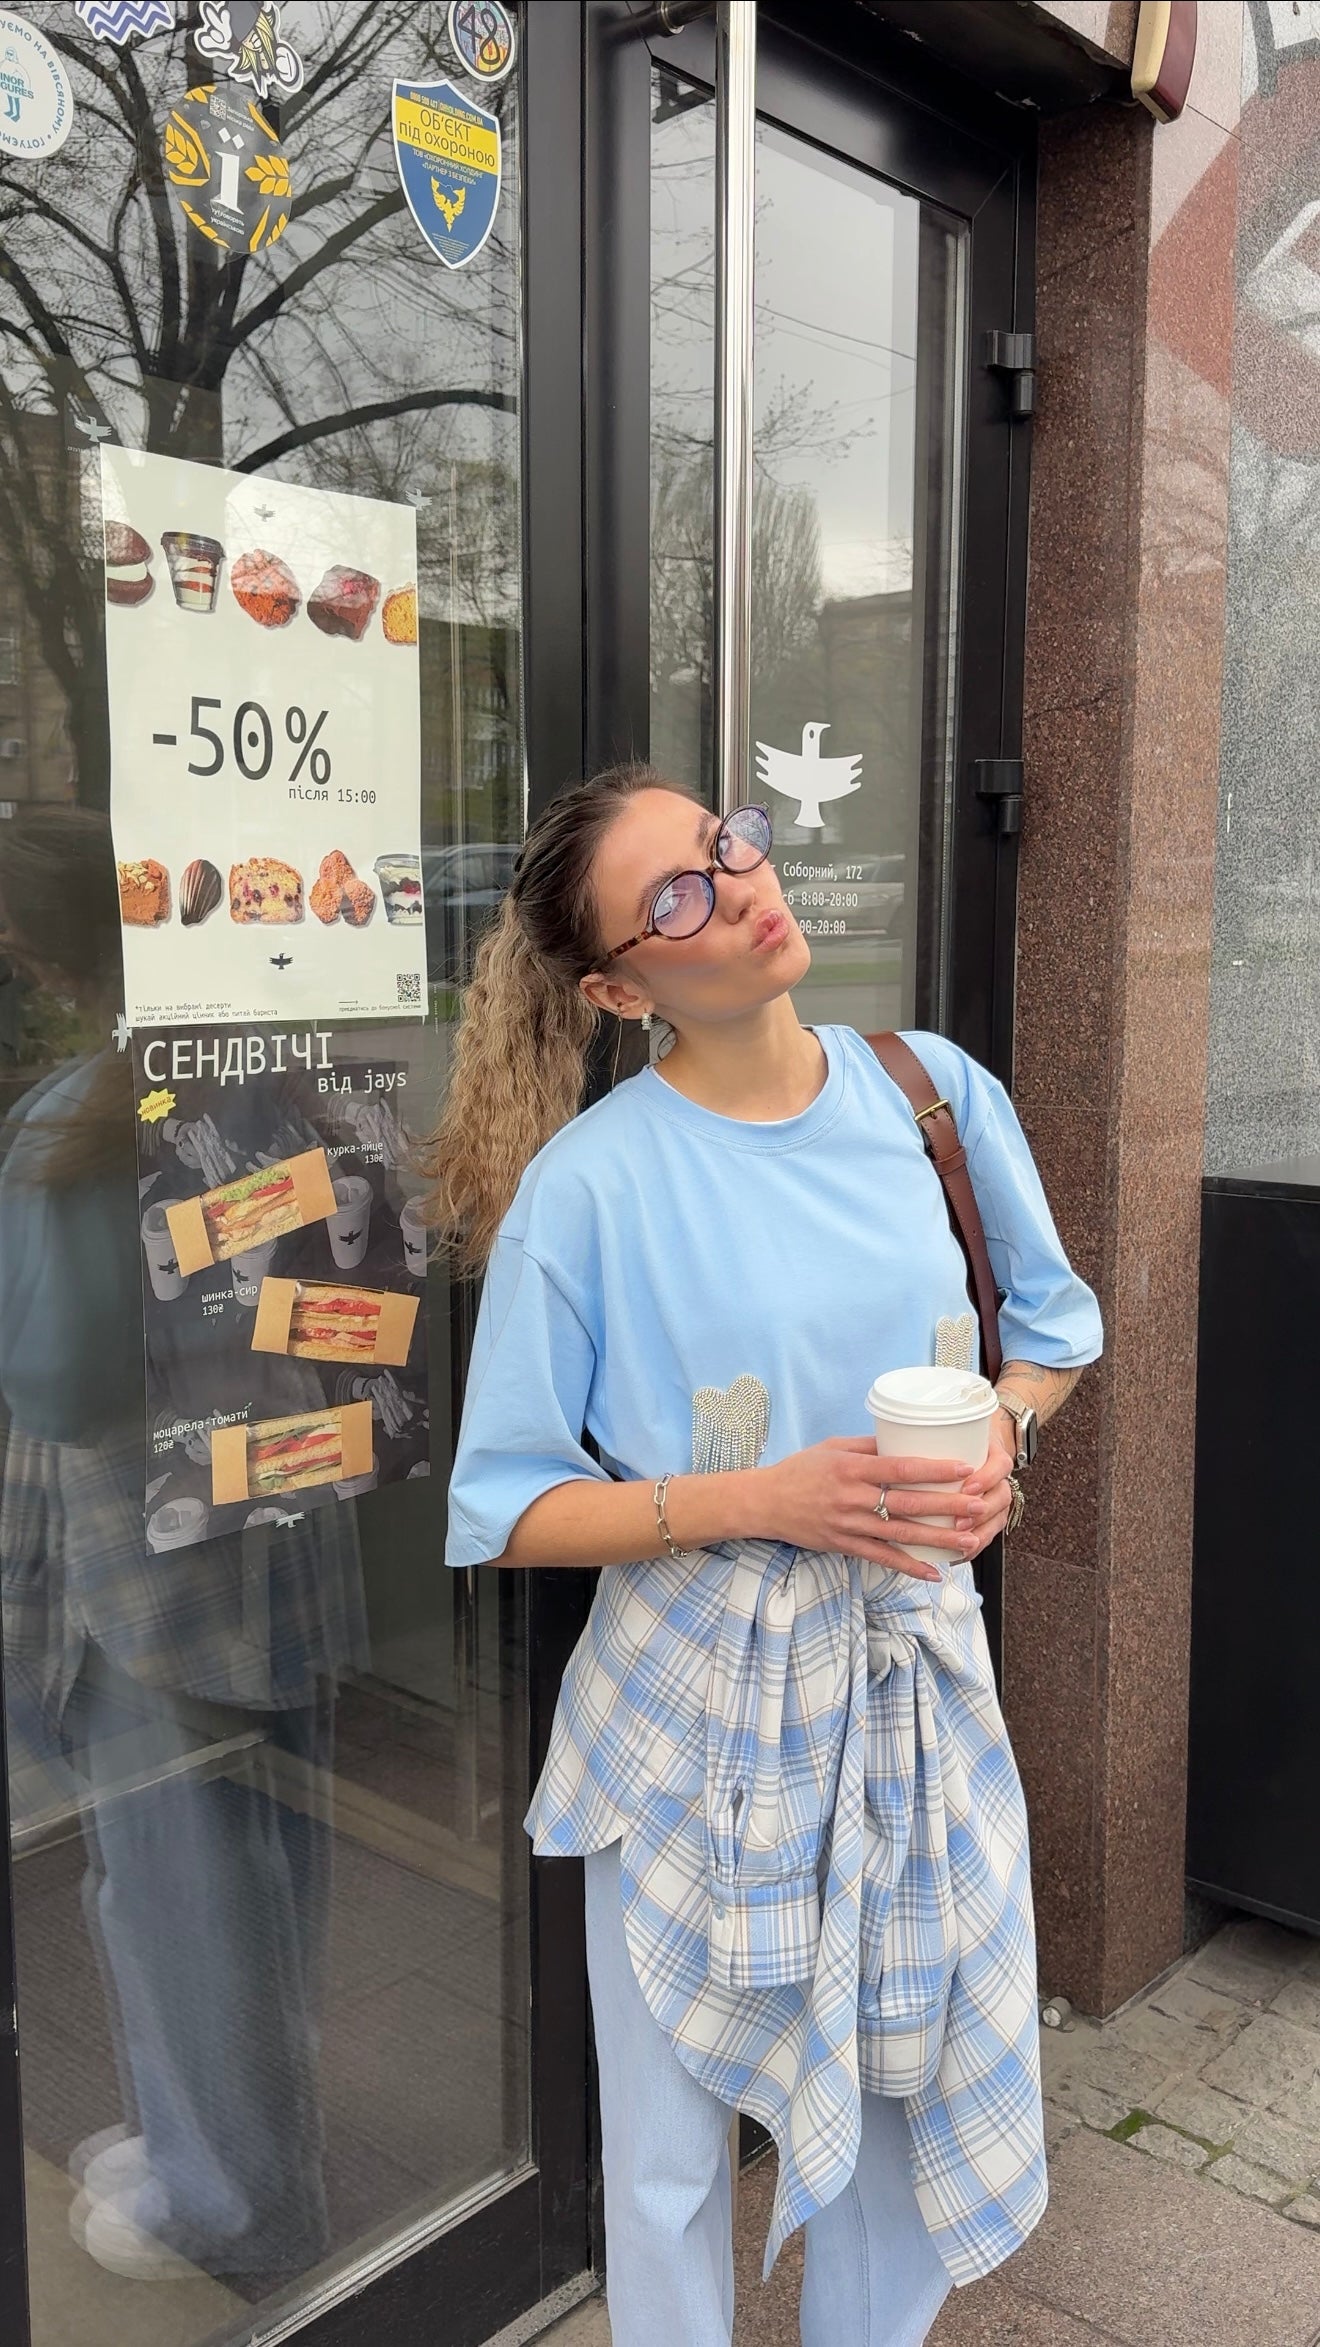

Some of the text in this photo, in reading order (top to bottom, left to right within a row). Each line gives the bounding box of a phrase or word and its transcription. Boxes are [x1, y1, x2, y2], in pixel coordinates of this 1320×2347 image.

[458, 4, 500, 65] 48
[33, 40, 48, 60] НА
[47, 60, 66, 135] ВІВСЯНОМУ
[0, 131, 45, 149] ГОТУЄМ
[399, 120, 495, 168] під охороною
[152, 696, 332, 785] -50%
[288, 785, 377, 804] після 15:00
[783, 861, 863, 881] Соборний, 172
[801, 891, 858, 907] 8:00-20:00
[144, 1031, 333, 1087] СЕНДВІЧІ
[318, 1069, 407, 1095] від jays
[141, 1096, 172, 1116] новинка
[327, 1141, 384, 1158] курка-яйце
[201, 1285, 258, 1303] шинка-сир
[153, 1410, 248, 1441] моцарела-томати
